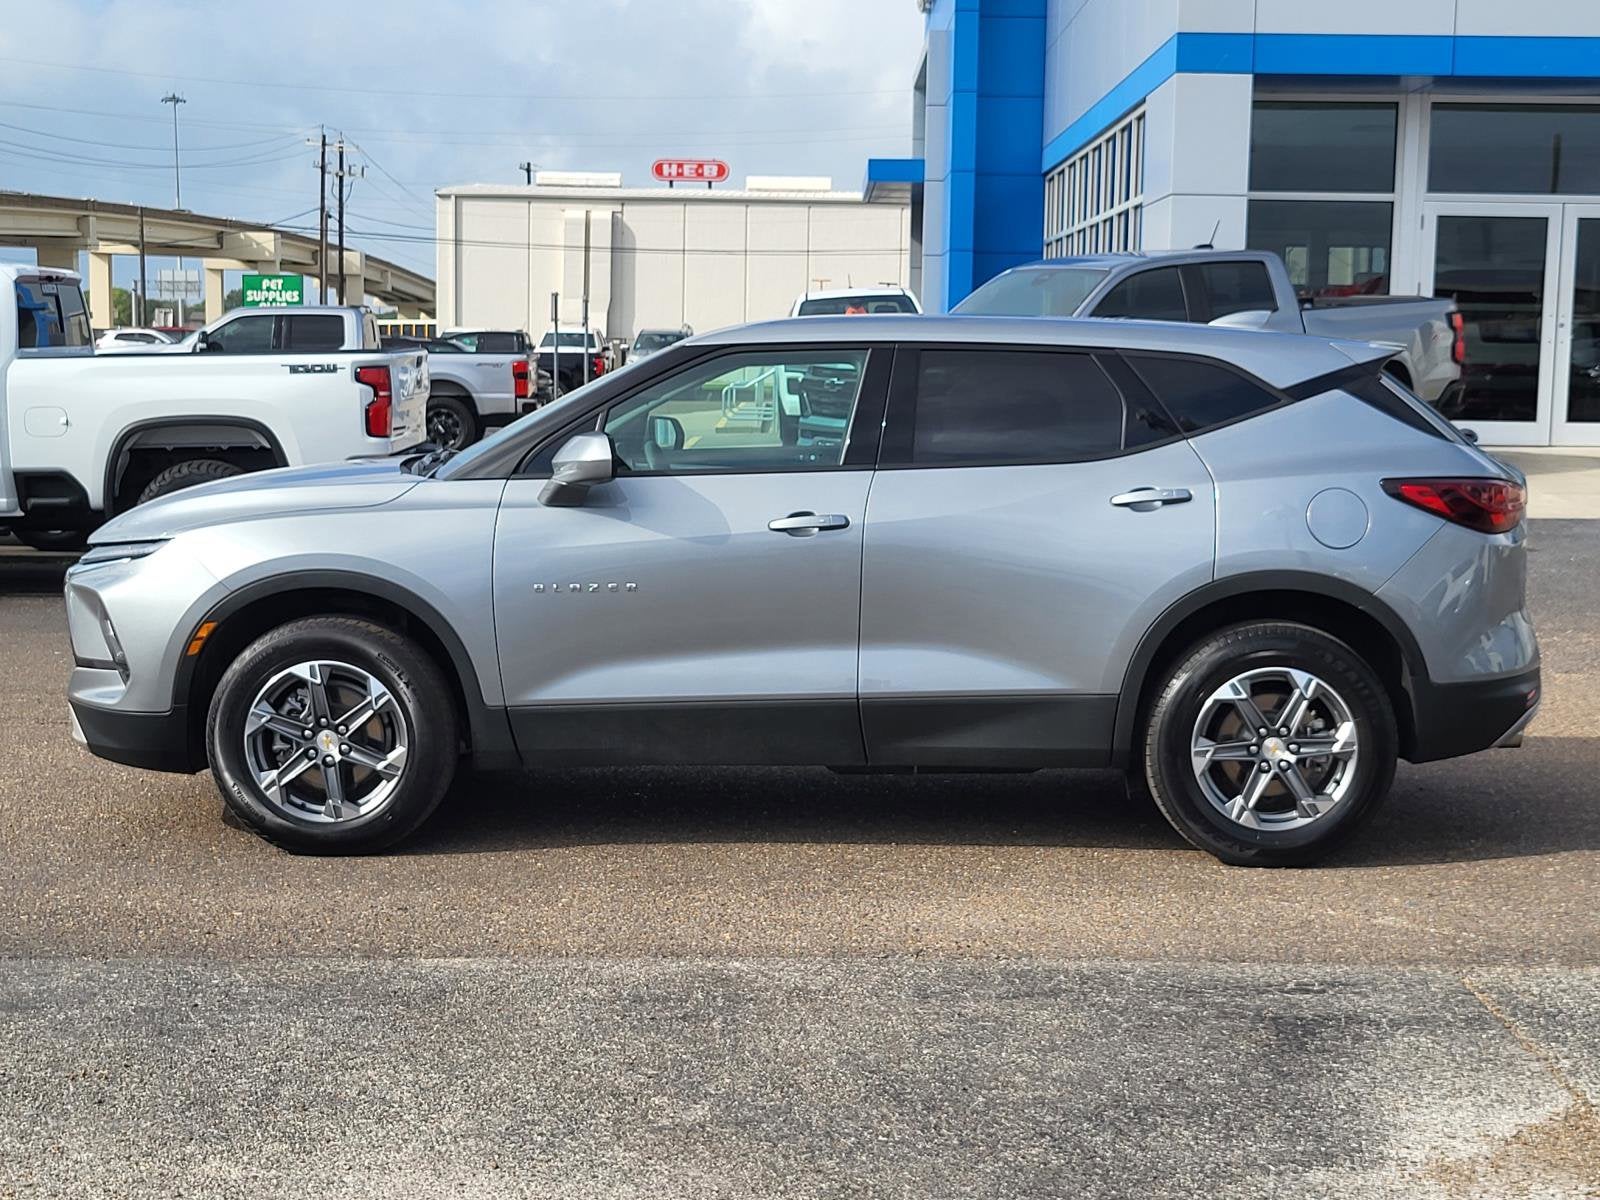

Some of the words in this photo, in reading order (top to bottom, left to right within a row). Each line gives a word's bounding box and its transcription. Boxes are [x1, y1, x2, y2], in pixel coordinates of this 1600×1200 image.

[262, 278, 283, 290] PET
[246, 289, 299, 302] SUPPLIES
[533, 582, 638, 593] BLAZER
